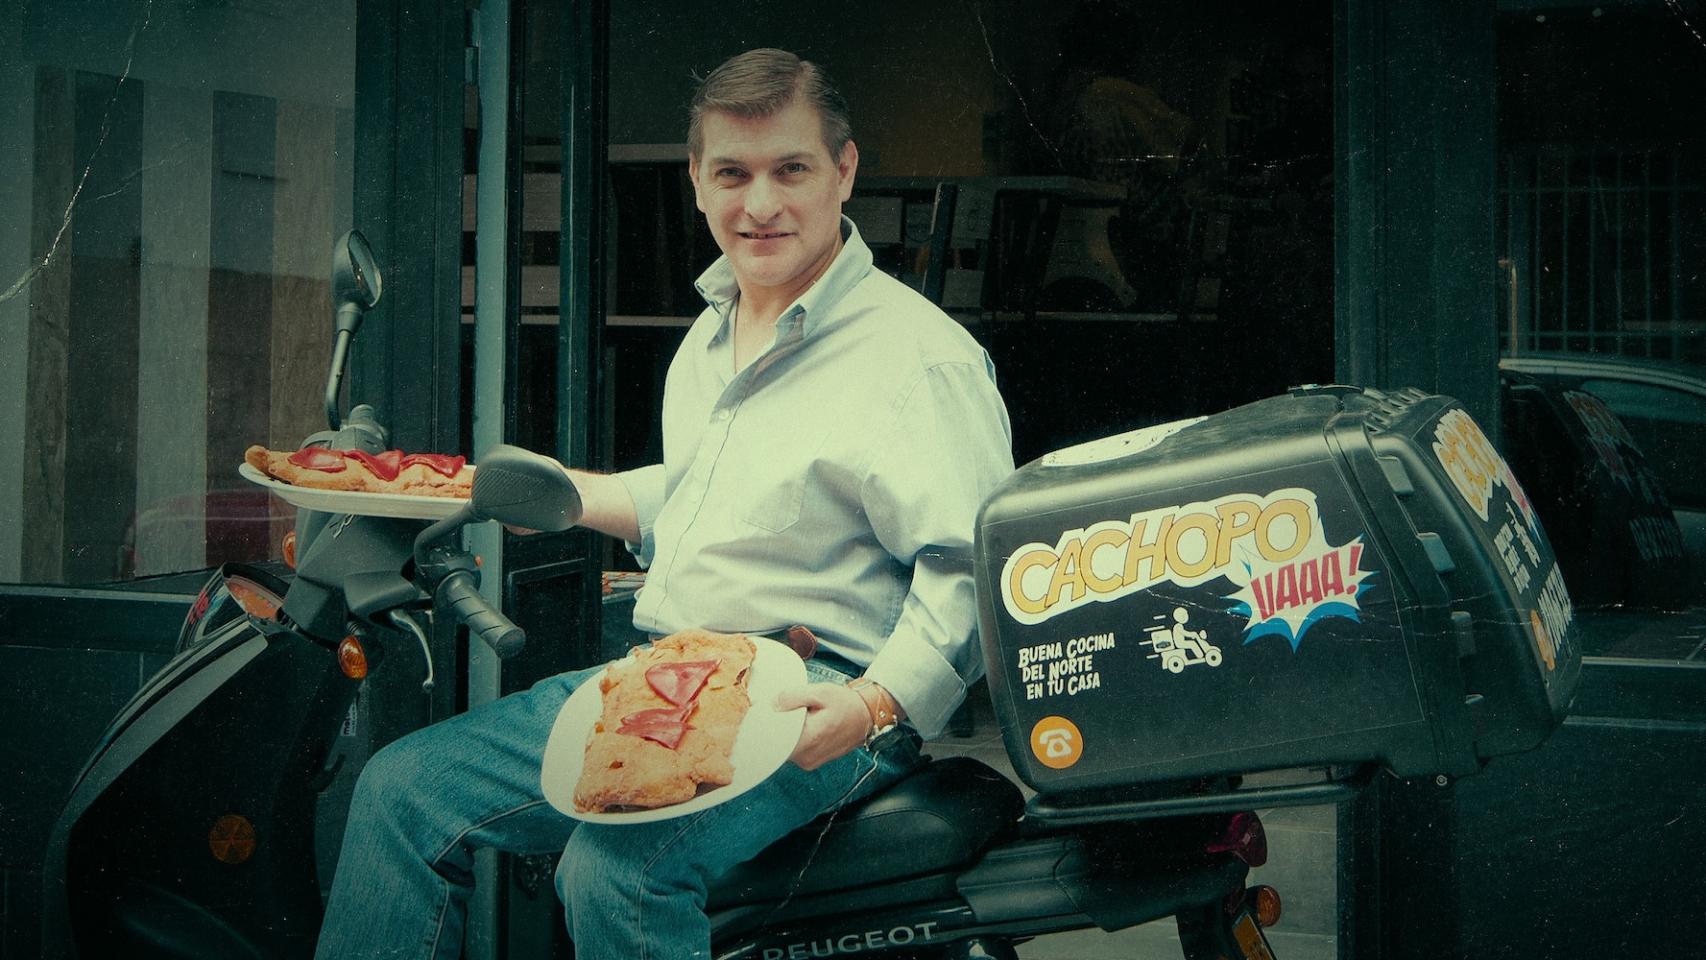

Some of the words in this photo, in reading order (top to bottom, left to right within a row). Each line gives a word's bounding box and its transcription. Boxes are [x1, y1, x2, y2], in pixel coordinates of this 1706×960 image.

[1009, 498, 1312, 614] CACHOPO
[1250, 545, 1363, 621] VAAA!
[1018, 642, 1062, 668] BUENA
[1066, 632, 1115, 658] COCINA
[1022, 664, 1045, 682] DEL
[1049, 655, 1093, 680] NORTE
[1026, 683, 1043, 700] EN
[1047, 679, 1063, 696] TU
[1068, 672, 1100, 695] CASA
